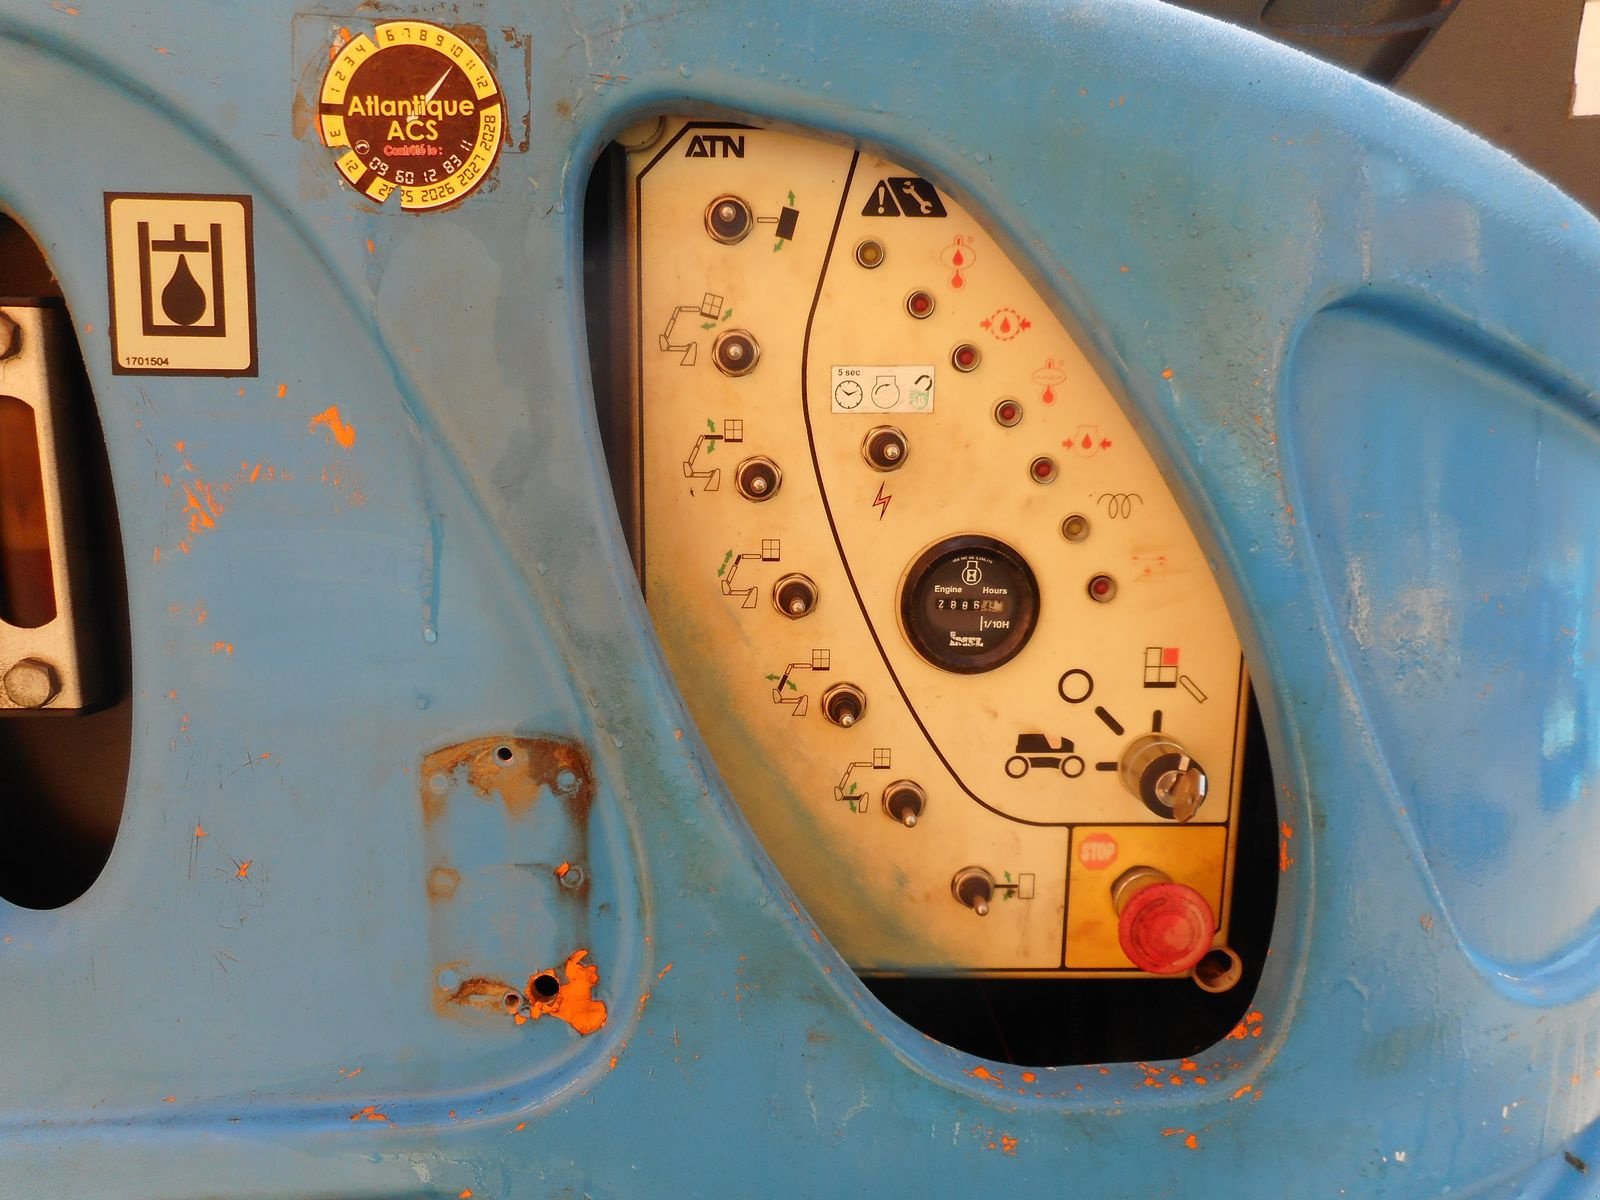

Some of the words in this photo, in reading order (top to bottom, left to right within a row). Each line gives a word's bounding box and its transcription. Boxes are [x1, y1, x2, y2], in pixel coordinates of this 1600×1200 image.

[335, 70, 346, 81] 2
[344, 56, 355, 67] 3
[386, 30, 395, 41] 6
[403, 28, 411, 38] 7
[420, 30, 427, 41] 8
[436, 35, 444, 46] 9
[451, 44, 464, 58] 10
[466, 60, 476, 70] 11
[476, 76, 488, 88] 12
[348, 95, 475, 121] Atlantique
[387, 120, 439, 141] ACS
[685, 135, 745, 158] ATN
[346, 160, 359, 173] 12
[369, 157, 389, 176] 09
[395, 170, 414, 184] 60
[424, 169, 438, 183] 12
[443, 154, 462, 174] 83
[460, 140, 473, 151] 11
[379, 184, 414, 203] 25
[421, 183, 455, 202] 2026
[457, 154, 486, 186] 2027
[480, 115, 496, 151] 2028
[125, 357, 169, 366] 1701504
[838, 368, 843, 376] 5
[934, 585, 963, 595] Engine
[982, 586, 1008, 595] Hours
[984, 620, 1010, 629] 1/10H
[1080, 842, 1116, 861] STOP
